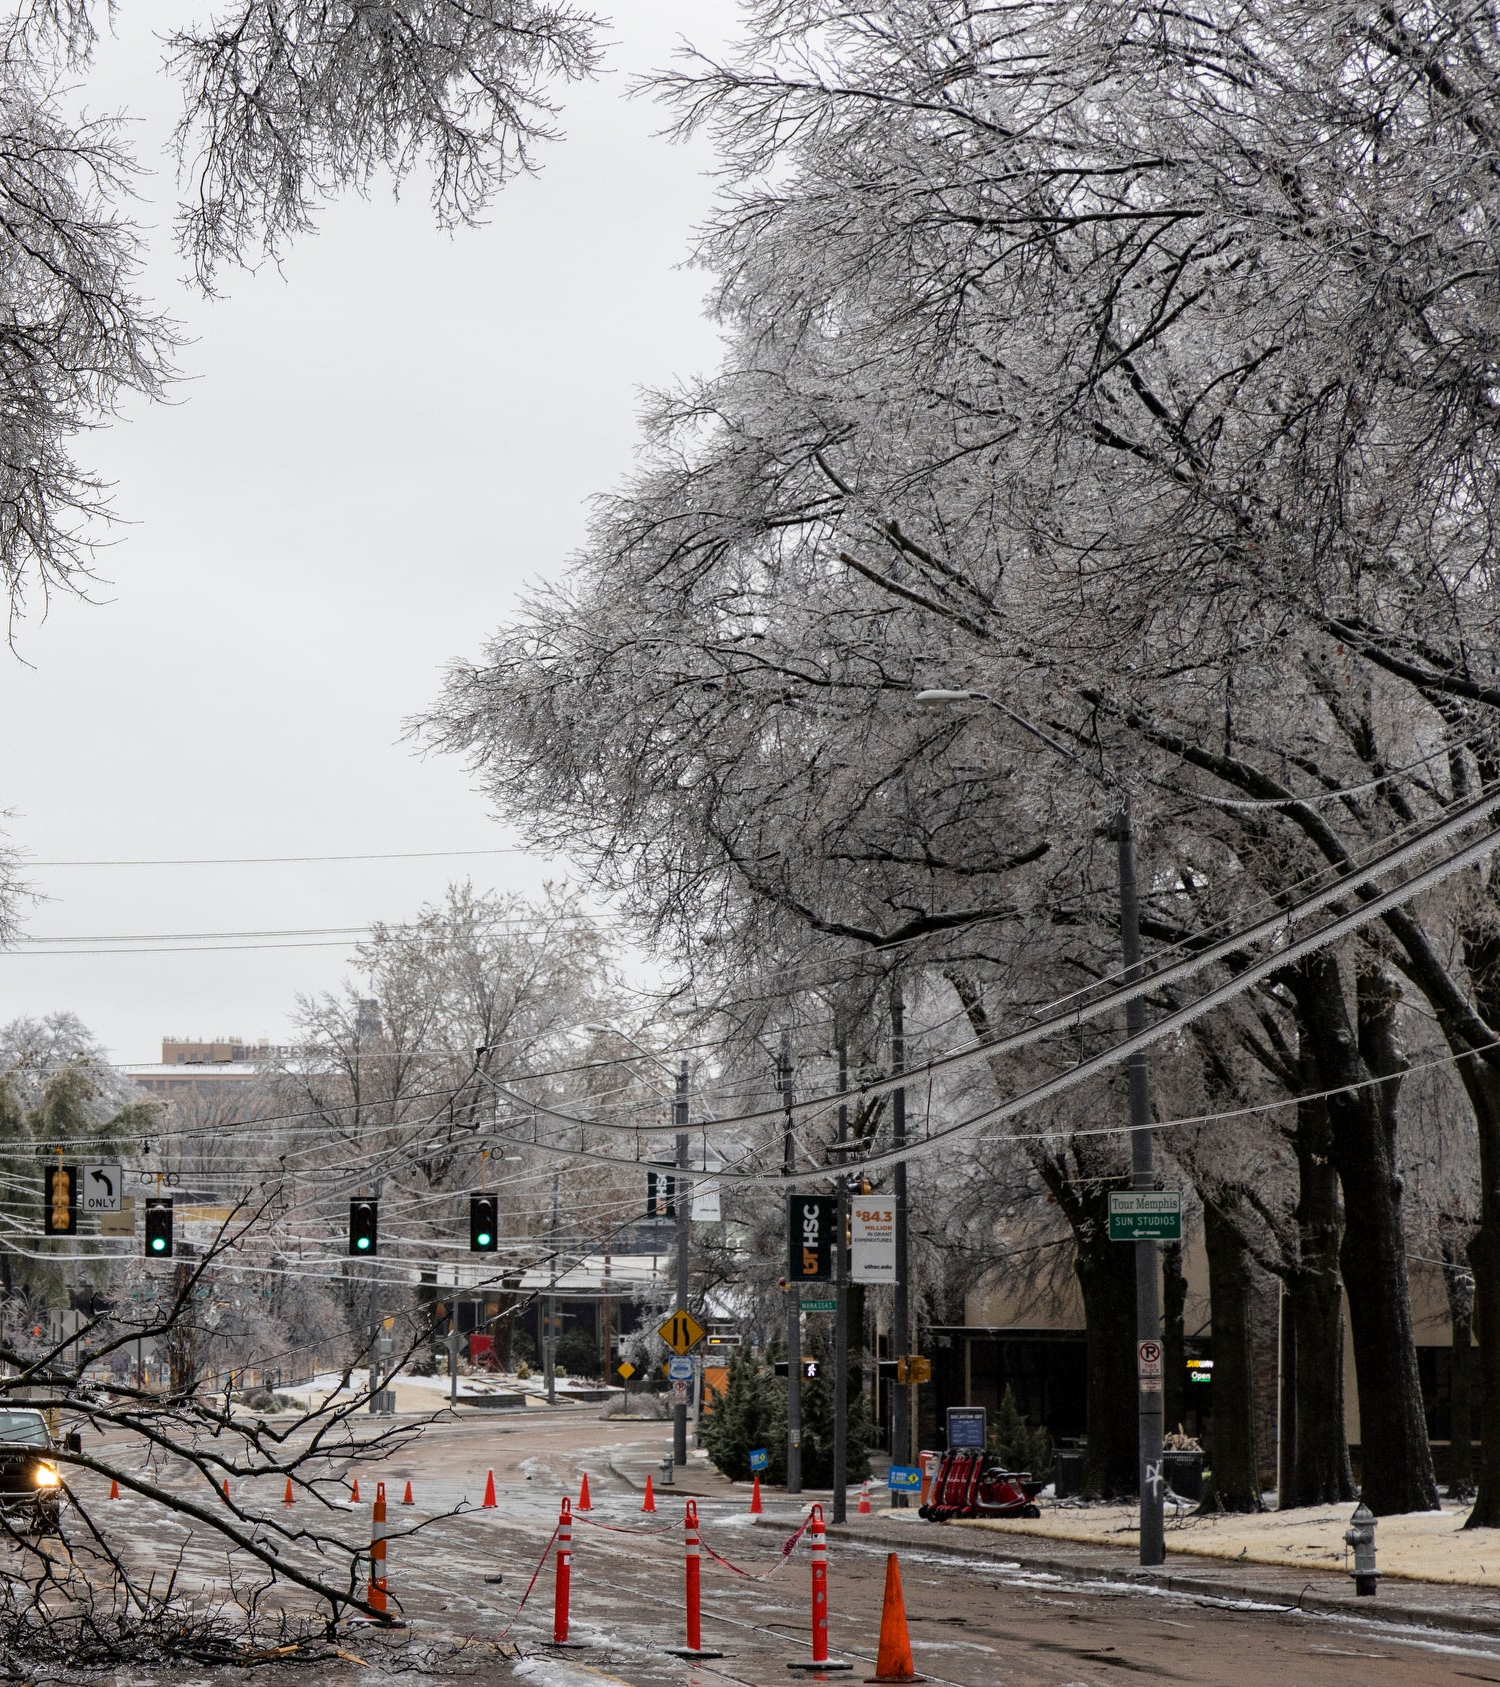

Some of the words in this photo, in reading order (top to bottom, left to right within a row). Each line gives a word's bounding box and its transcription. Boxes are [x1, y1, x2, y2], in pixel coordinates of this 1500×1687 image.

[88, 1198, 116, 1208] ONLY
[1112, 1198, 1134, 1210] Tour
[1136, 1197, 1178, 1212] Memphis
[855, 1210, 893, 1222] $84.3
[1115, 1216, 1133, 1226] SUN
[1137, 1216, 1176, 1226] STUDIOS
[1191, 1371, 1211, 1382] Open
